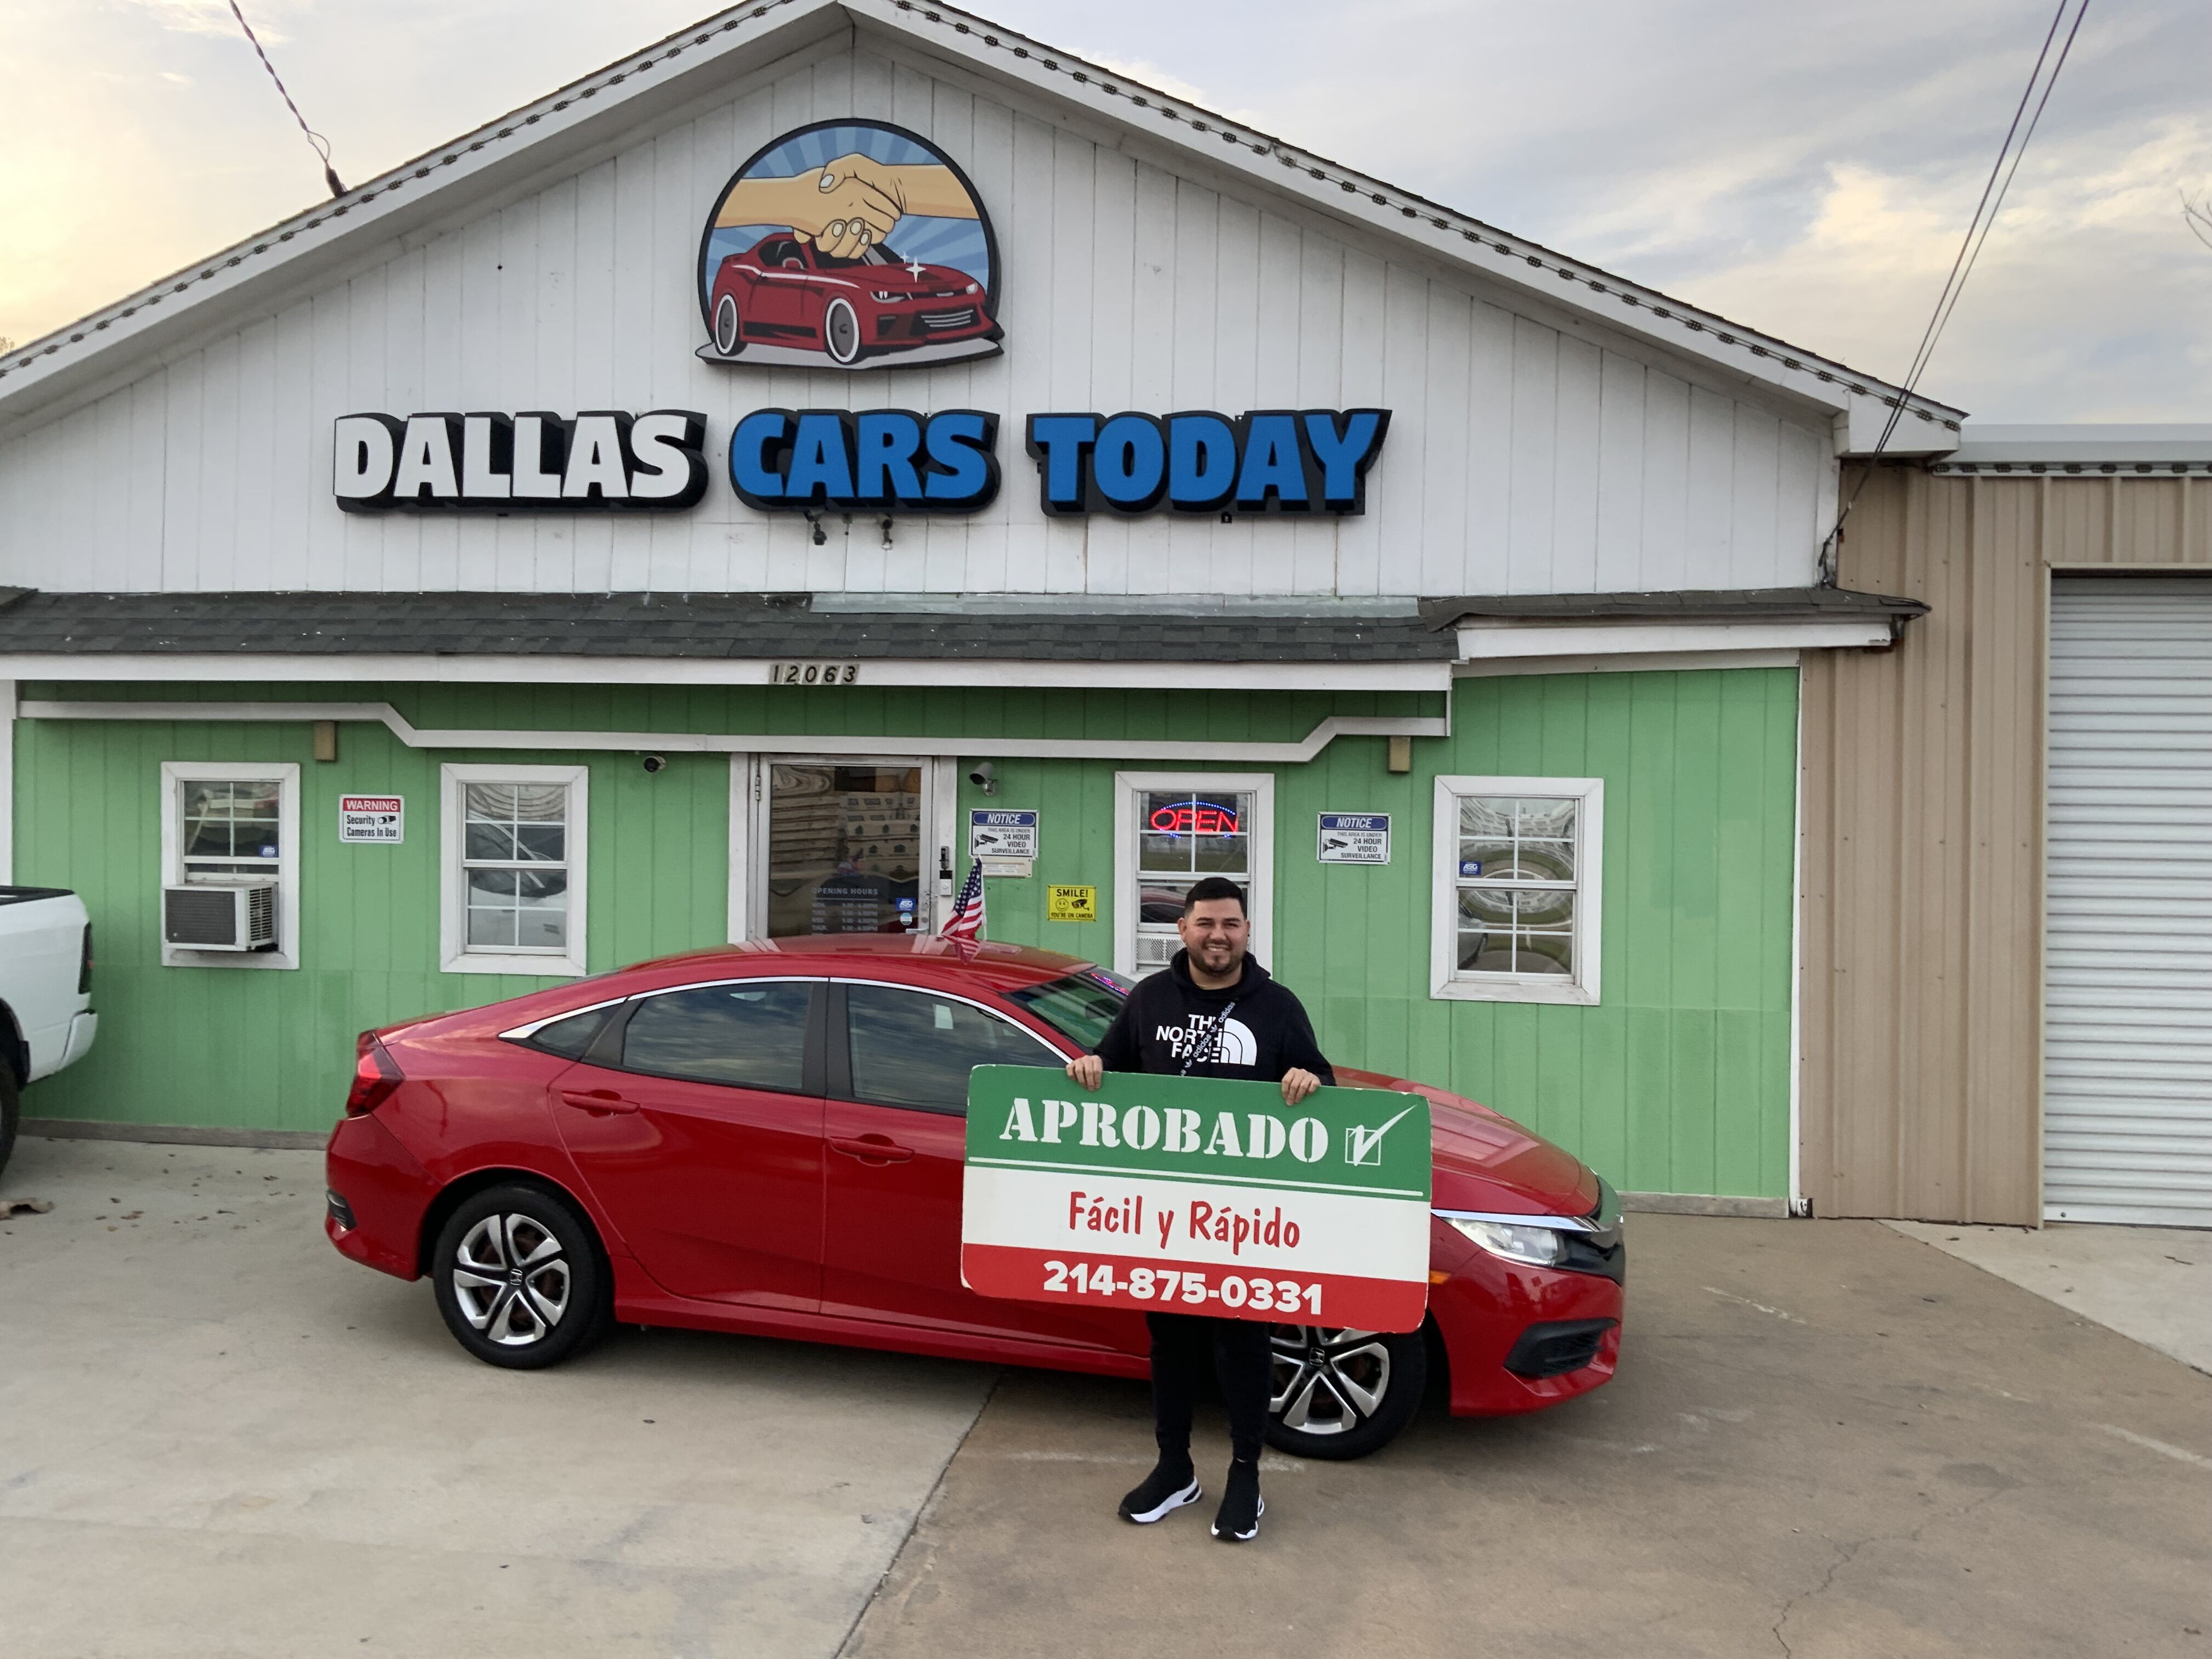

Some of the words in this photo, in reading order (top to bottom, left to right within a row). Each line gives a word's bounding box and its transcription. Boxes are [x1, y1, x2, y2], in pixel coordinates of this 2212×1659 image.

[333, 414, 691, 499] DALLAS
[732, 413, 989, 501] CARS
[1034, 413, 1381, 503] TODAY
[774, 664, 856, 683] 12063
[346, 800, 398, 811] WARNING
[346, 815, 375, 826] Security
[987, 813, 1022, 824] NOTICE
[1150, 809, 1239, 833] OPEN
[1336, 817, 1373, 828] NOTICE
[347, 827, 375, 837] Cameras
[377, 827, 383, 837] In
[385, 827, 396, 837] Use
[1056, 889, 1088, 898] SMILE!
[1218, 1001, 1235, 1023] adidas
[1188, 1014, 1216, 1030] TH
[1193, 1034, 1212, 1058] adidas
[998, 1097, 1329, 1164] APROBADO
[1069, 1190, 1143, 1235] Fácil
[1158, 1210, 1175, 1250] y
[1189, 1200, 1300, 1256] Rápido
[1043, 1260, 1322, 1316] 214-875-0331
